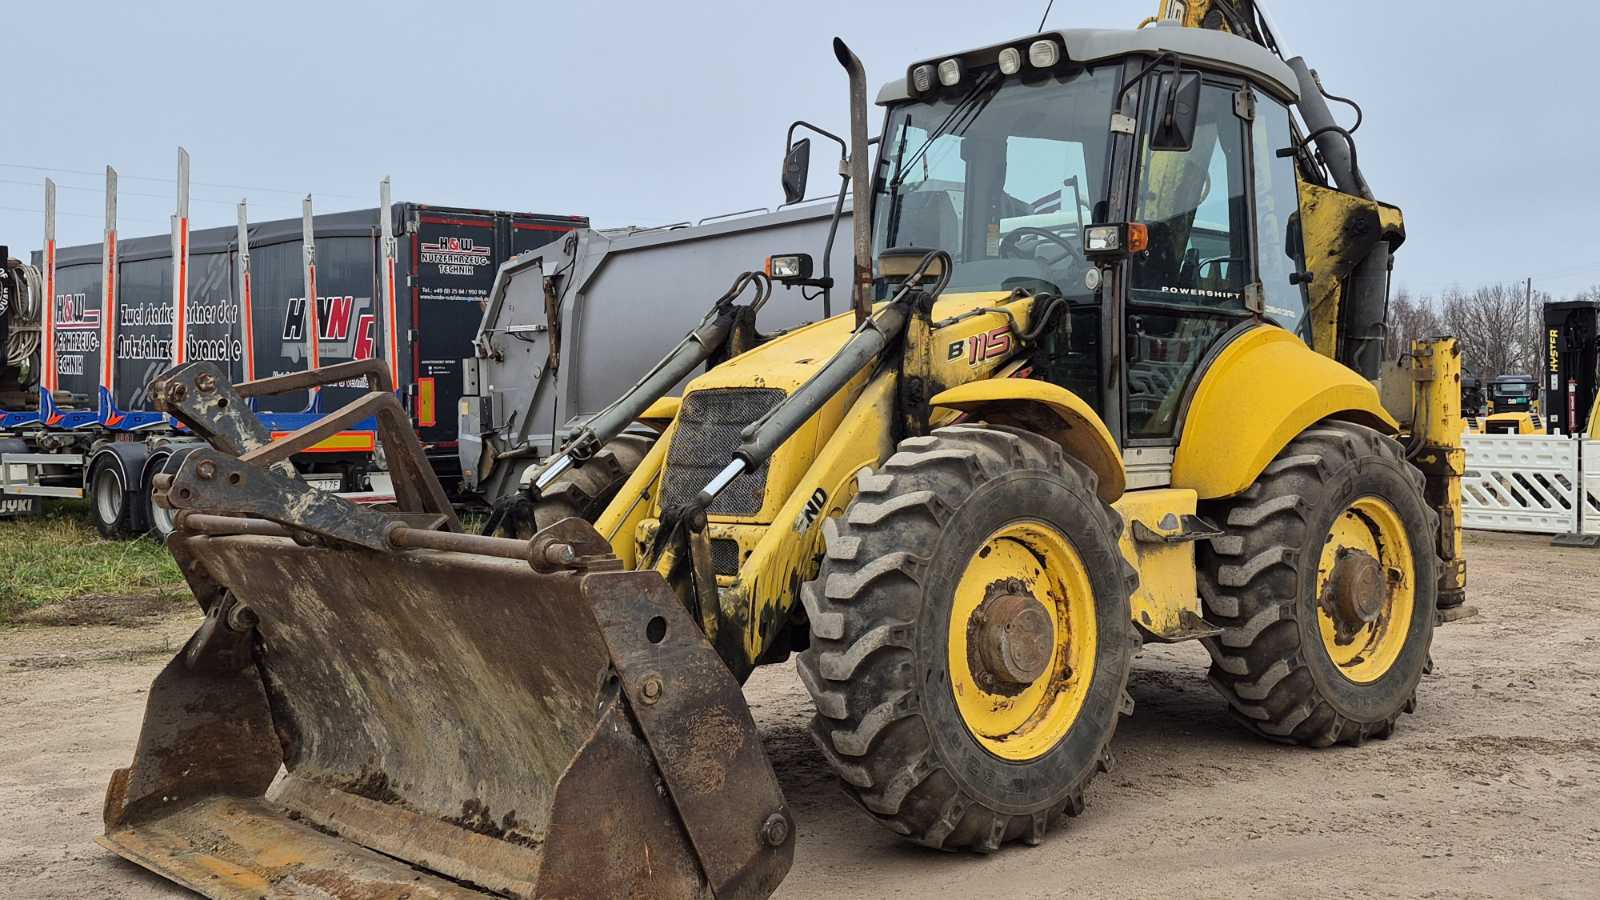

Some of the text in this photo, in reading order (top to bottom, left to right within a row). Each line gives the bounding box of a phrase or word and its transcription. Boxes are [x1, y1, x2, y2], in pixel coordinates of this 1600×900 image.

[439, 236, 473, 252] H&W
[1161, 286, 1241, 300] POWERSHIFT
[120, 302, 144, 326] Zwei
[946, 325, 1011, 366] B 115
[1550, 329, 1559, 372] HYSTER
